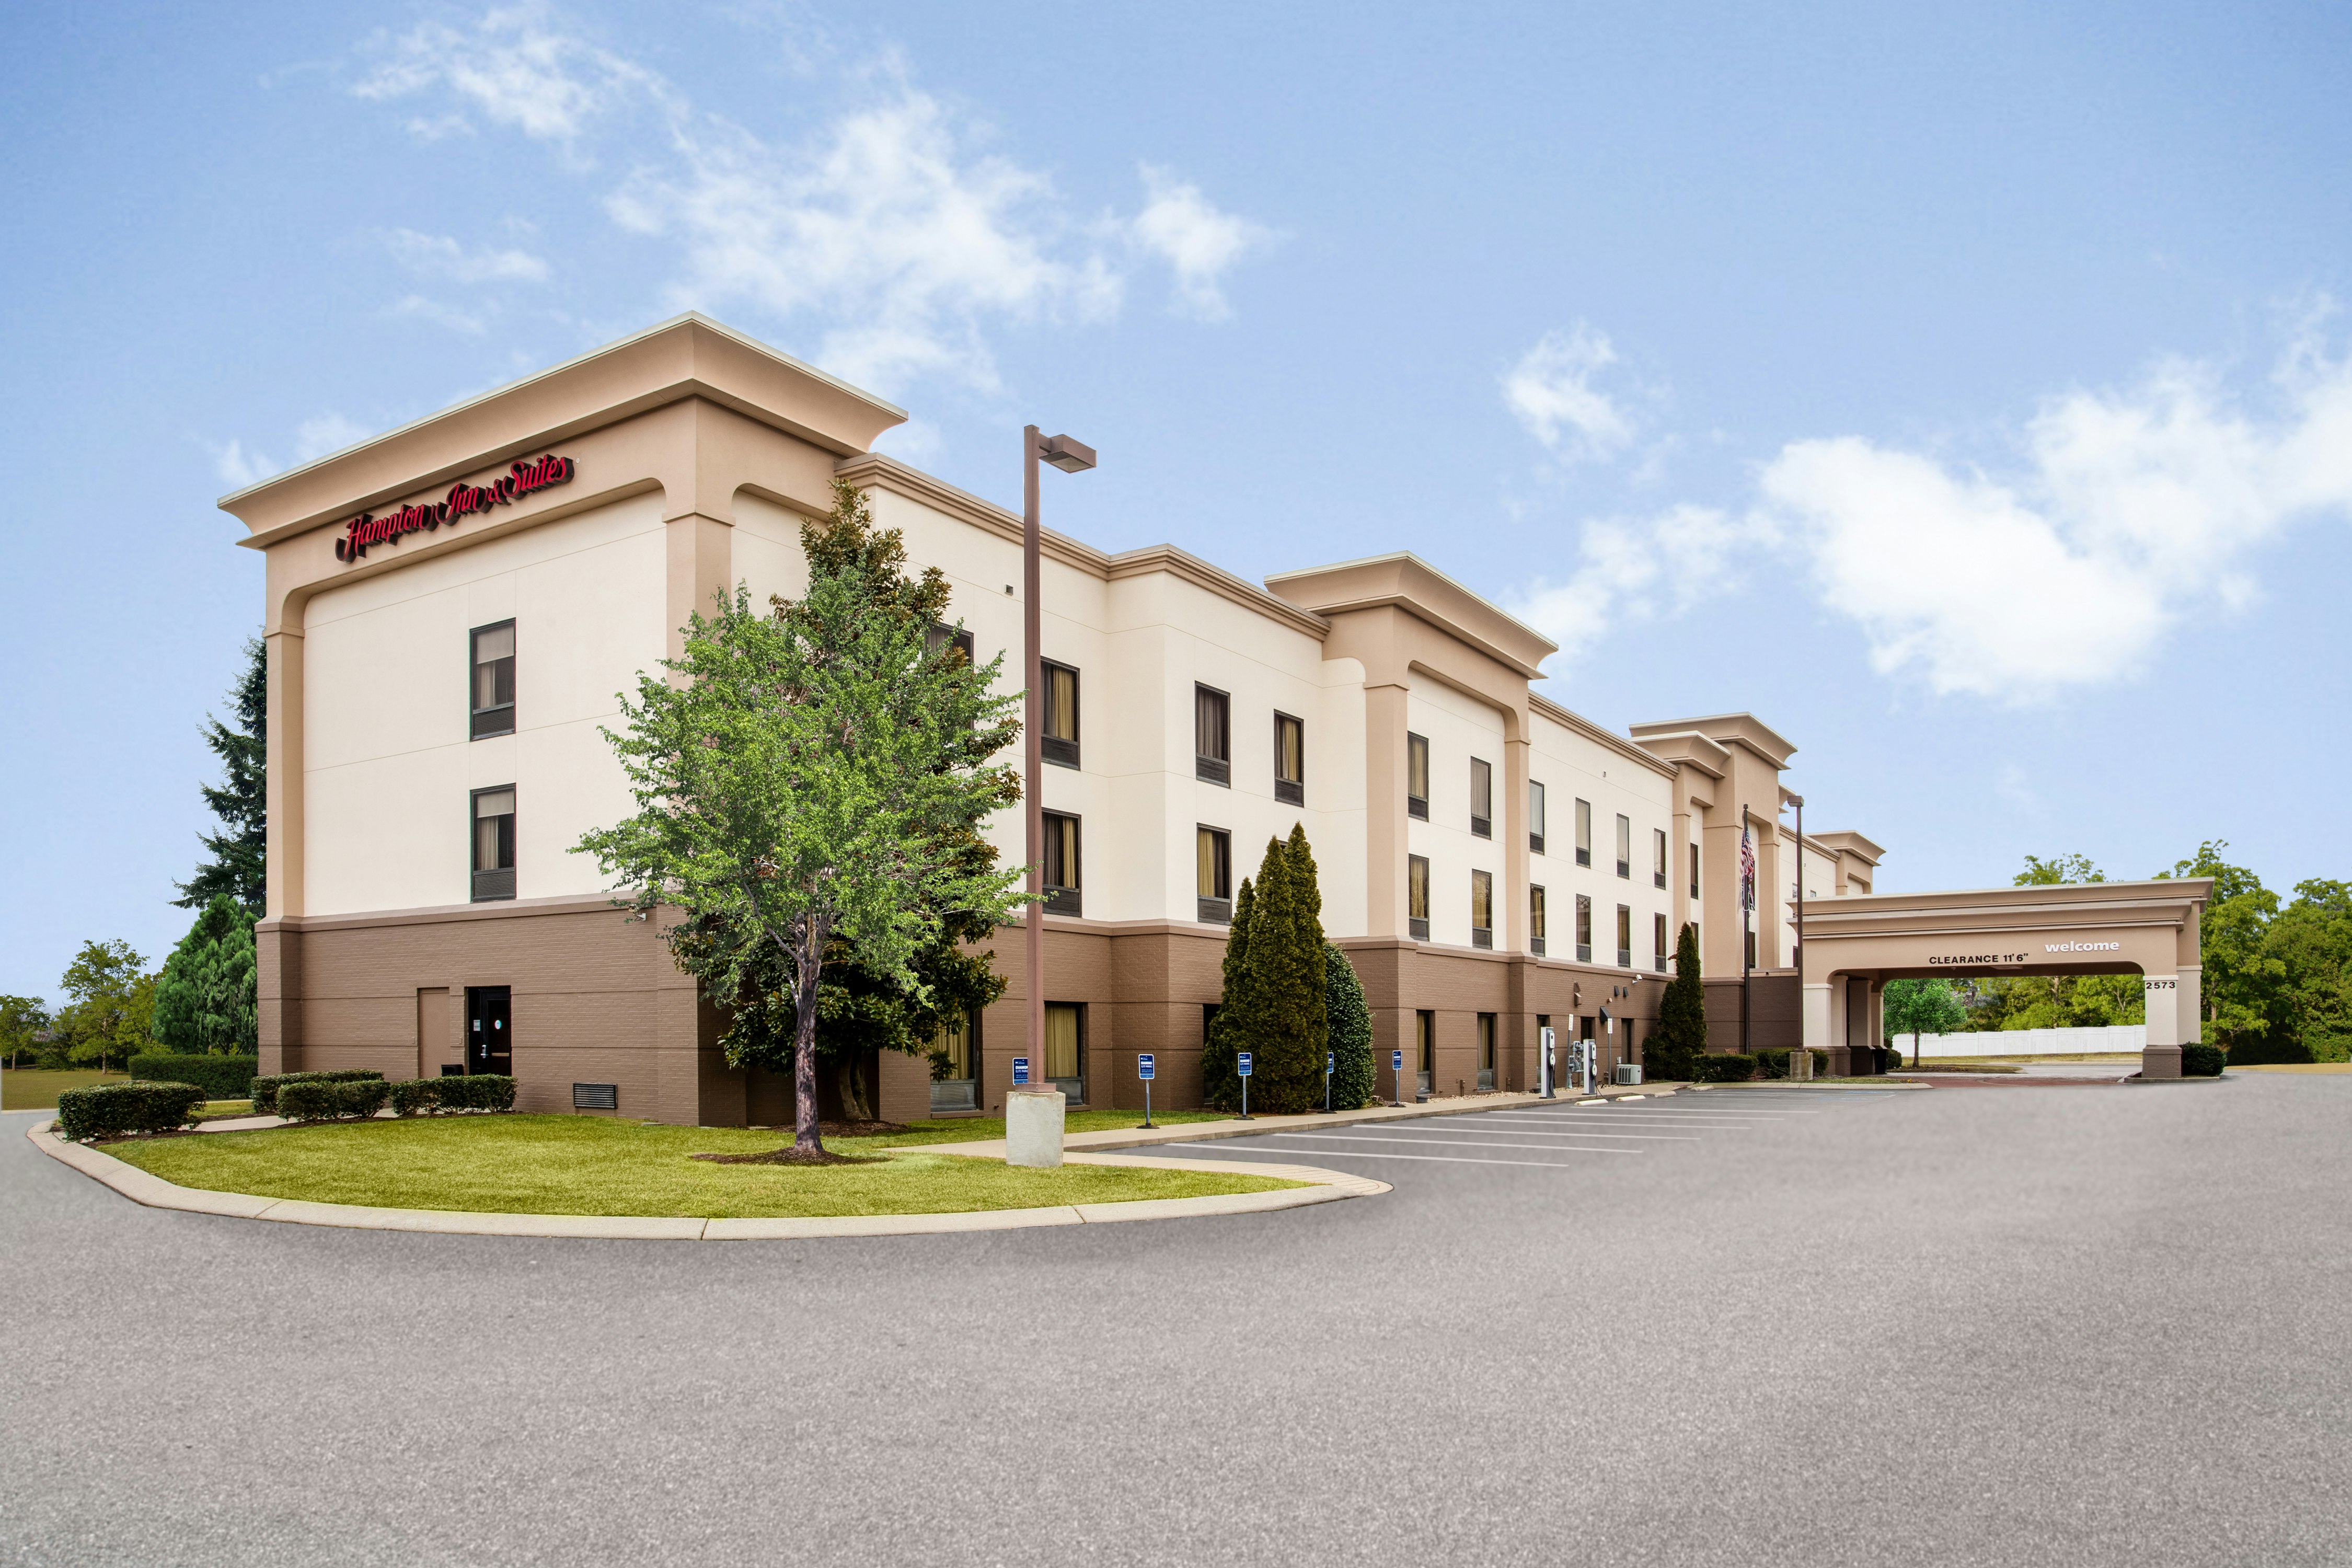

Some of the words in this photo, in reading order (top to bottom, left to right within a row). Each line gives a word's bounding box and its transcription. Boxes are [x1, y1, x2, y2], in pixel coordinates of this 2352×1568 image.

[335, 503, 437, 564] Hampton
[435, 483, 494, 526] Inn
[488, 478, 511, 505] &
[502, 454, 575, 500] Suites
[2045, 940, 2119, 952] welcome
[1929, 955, 1999, 964] CLEARANCE
